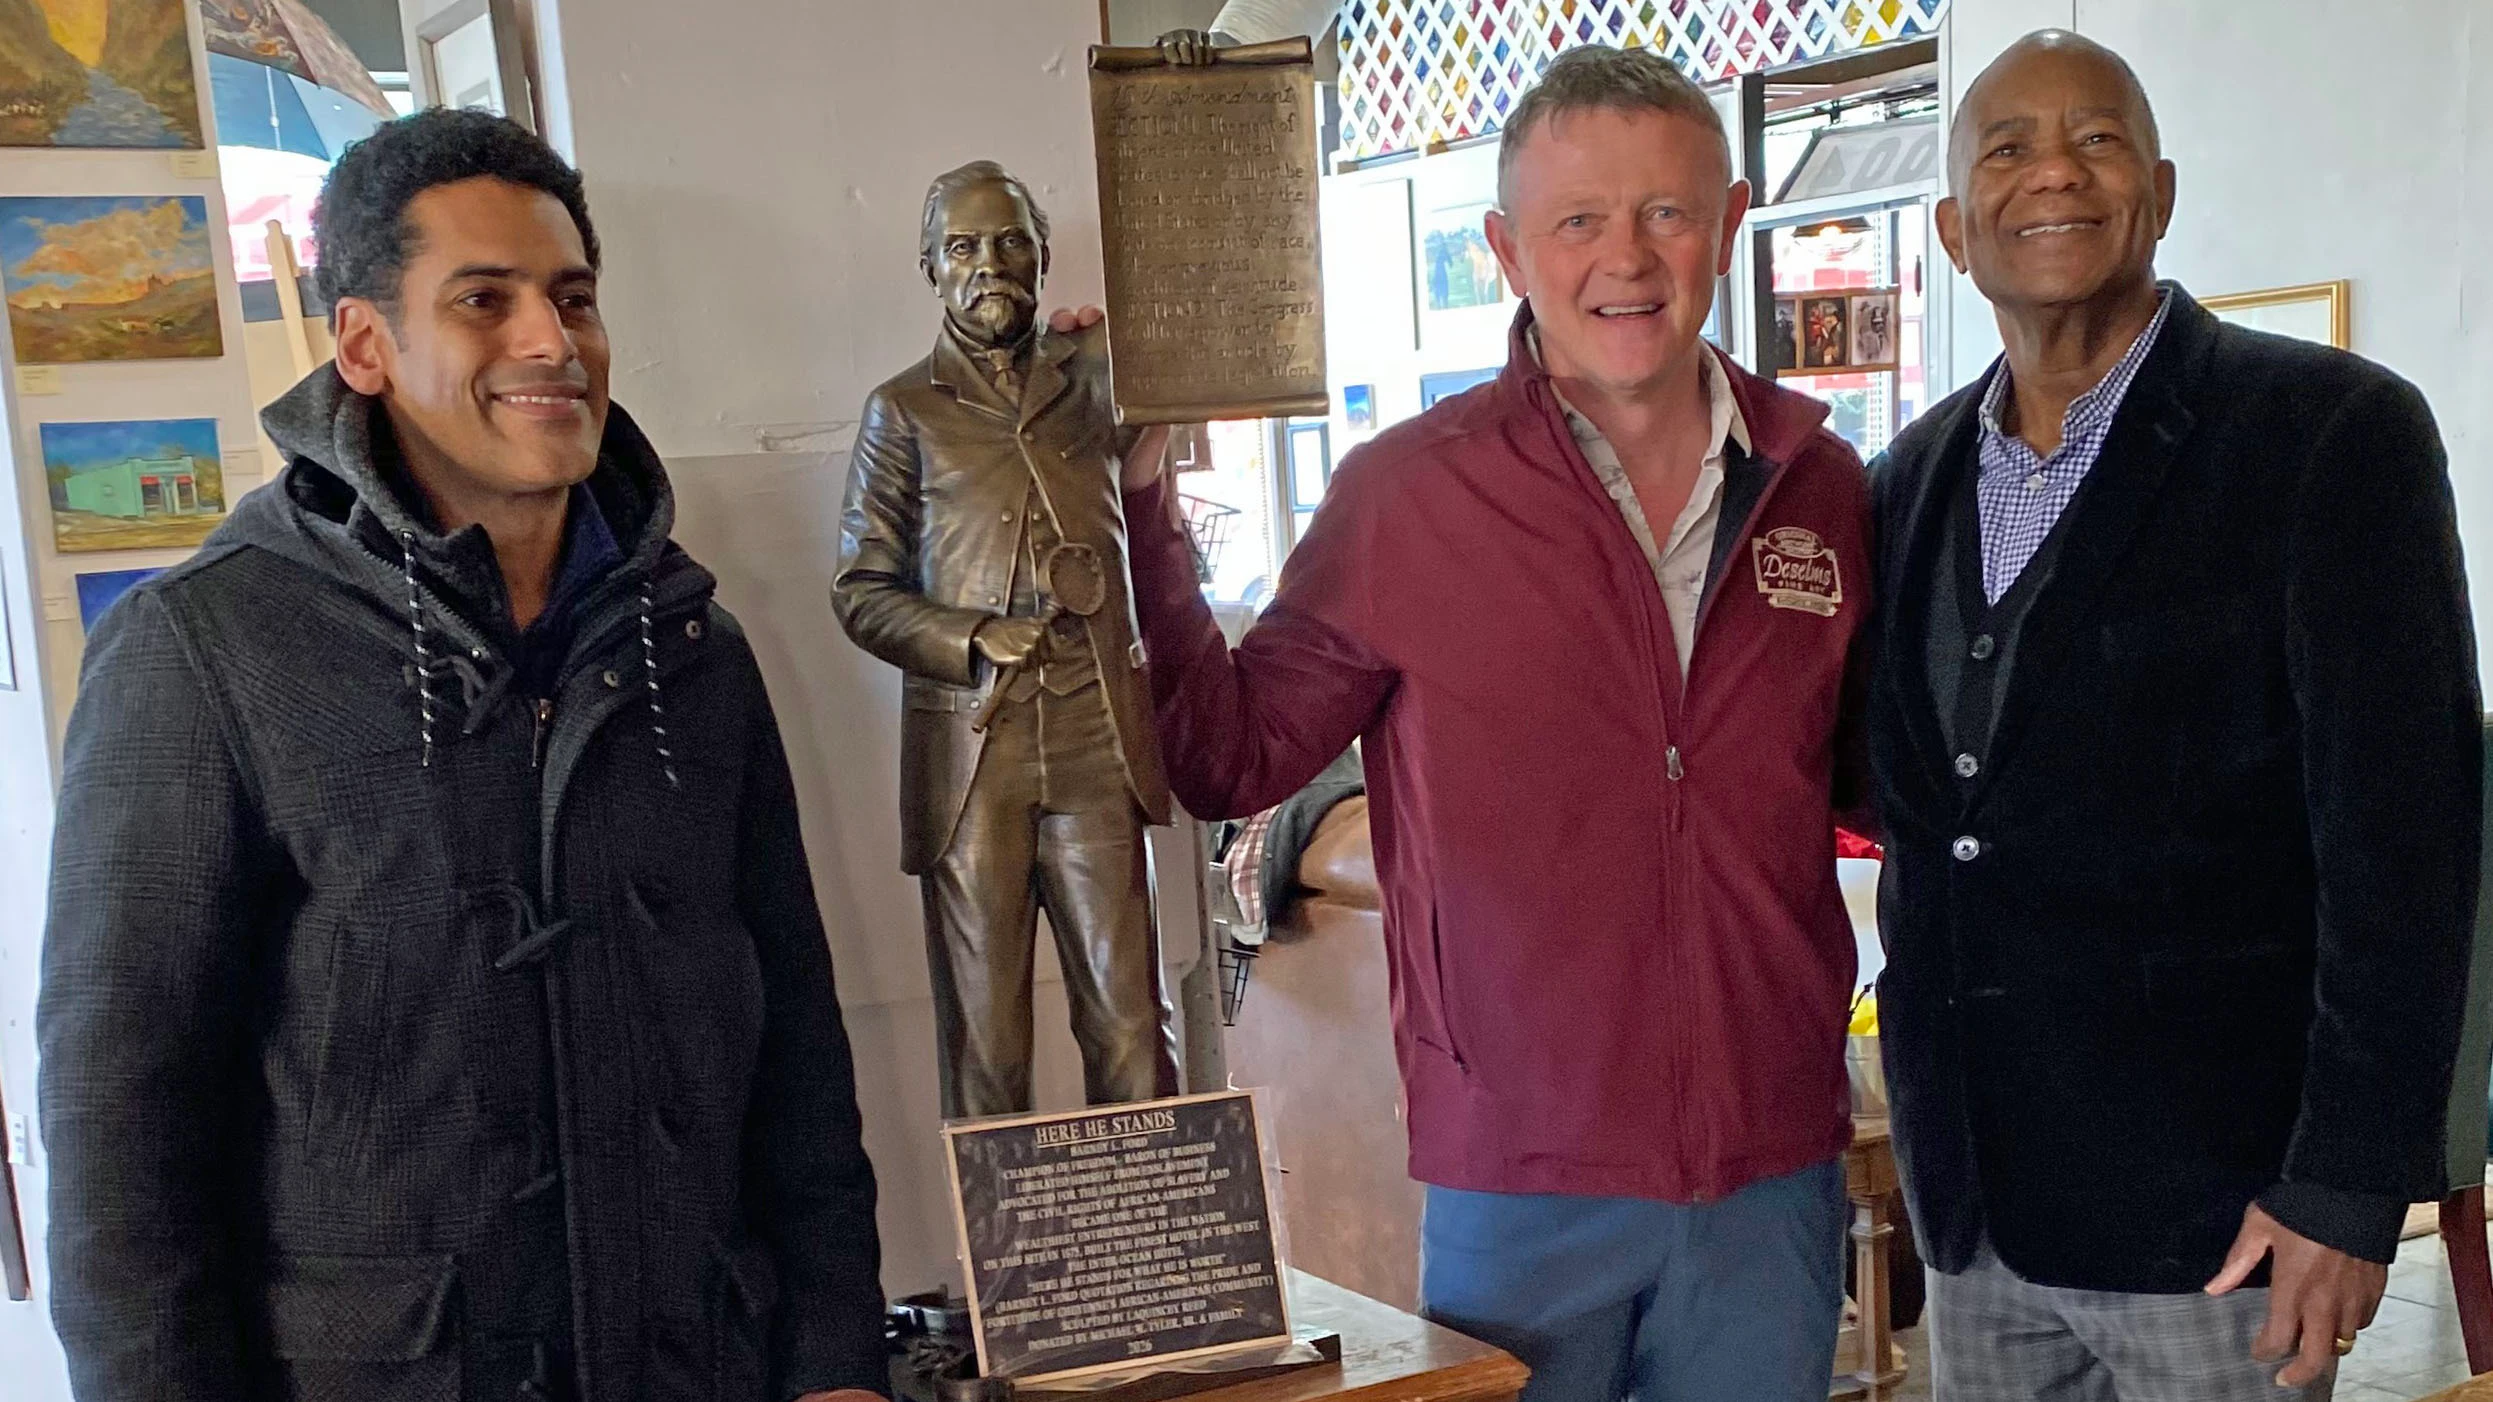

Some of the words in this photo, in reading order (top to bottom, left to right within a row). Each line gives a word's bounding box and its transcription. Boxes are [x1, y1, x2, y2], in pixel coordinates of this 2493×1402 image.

[1279, 112, 1296, 134] of
[1283, 161, 1303, 179] be
[1278, 184, 1304, 203] the
[1251, 231, 1266, 249] of
[1275, 338, 1297, 362] by
[1763, 554, 1831, 586] Deselms
[1035, 1123, 1081, 1144] HERE
[1085, 1119, 1107, 1137] HE
[1112, 1110, 1175, 1133] STANDS
[1070, 1142, 1108, 1156] BARNEY
[1121, 1136, 1148, 1149] FORD
[1003, 1164, 1054, 1180] CHAMPION
[1056, 1162, 1069, 1172] OF
[1071, 1155, 1116, 1170] FREEDOM
[1124, 1149, 1157, 1163] BARON
[1157, 1147, 1172, 1158] OF
[1172, 1141, 1216, 1156] BUSINESS
[1113, 1166, 1140, 1179] FROM
[997, 1193, 1056, 1210] ADVOCATED
[1057, 1190, 1076, 1201] FOR
[1077, 1187, 1098, 1198] THE
[1099, 1179, 1150, 1195] ABOLITION
[1151, 1177, 1166, 1188] OF
[1166, 1171, 1207, 1186] SLAVERY
[1209, 1168, 1230, 1180] AND
[1016, 1210, 1037, 1221] THE
[1038, 1206, 1066, 1218] CIVIL
[1067, 1201, 1102, 1214] RIGHTS
[1103, 1198, 1117, 1209] OF
[1071, 1214, 1110, 1228] BECAME
[1112, 1210, 1133, 1222] ONE
[1134, 1208, 1148, 1219] OF
[1148, 1205, 1168, 1217] THE
[1015, 1233, 1075, 1250] WEALTHIEST
[1078, 1222, 1156, 1241] ENTREPRENEURS
[1158, 1220, 1168, 1229] IN
[1170, 1217, 1190, 1228] THE
[1191, 1211, 1226, 1225] NATION
[983, 1259, 998, 1270] ON
[1000, 1255, 1022, 1267] THIS
[1047, 1250, 1058, 1260] IN
[1084, 1242, 1111, 1255] BUILT
[1113, 1239, 1133, 1251] THE
[1134, 1234, 1167, 1247] FINEST
[1168, 1229, 1200, 1242] HOTEL
[1201, 1227, 1213, 1237] IN
[1215, 1224, 1233, 1235] THE
[1234, 1220, 1260, 1232] WEST
[1067, 1260, 1087, 1271] THE
[1154, 1246, 1184, 1259] HOTEL
[1052, 1290, 1078, 1303] FORD
[1079, 1282, 1134, 1299] QUOTATION
[1191, 1270, 1211, 1282] THE
[1211, 1266, 1239, 1278] PRIDE
[1240, 1262, 1262, 1274] AND
[1060, 1277, 1073, 1287] HE
[1075, 1271, 1112, 1285] STANDS
[1113, 1268, 1132, 1279] FOR
[1133, 1264, 1162, 1276] WHAT
[1163, 1261, 1178, 1272] HE
[1178, 1260, 1188, 1270] IS
[1042, 1308, 1057, 1319] OF
[1111, 1312, 1124, 1323] BY
[1028, 1335, 1074, 1350] DONATED
[1074, 1333, 1086, 1343] BY
[1090, 1326, 1132, 1341] MICHAEL
